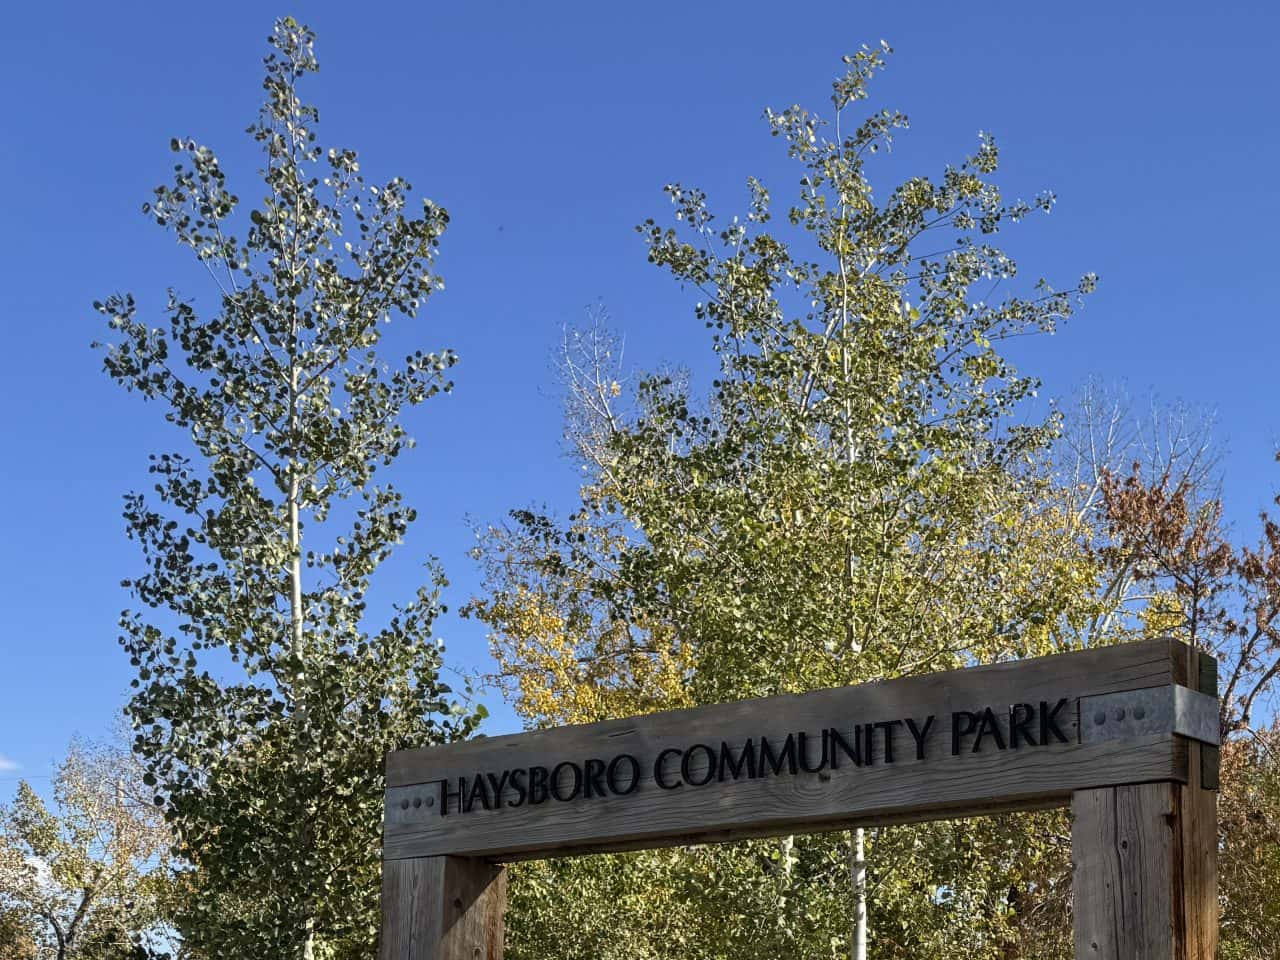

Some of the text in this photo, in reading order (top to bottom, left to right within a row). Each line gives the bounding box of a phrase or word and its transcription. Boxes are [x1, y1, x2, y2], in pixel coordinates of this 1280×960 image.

[440, 698, 1069, 816] HAYSBORO COMMUNITY PARK
